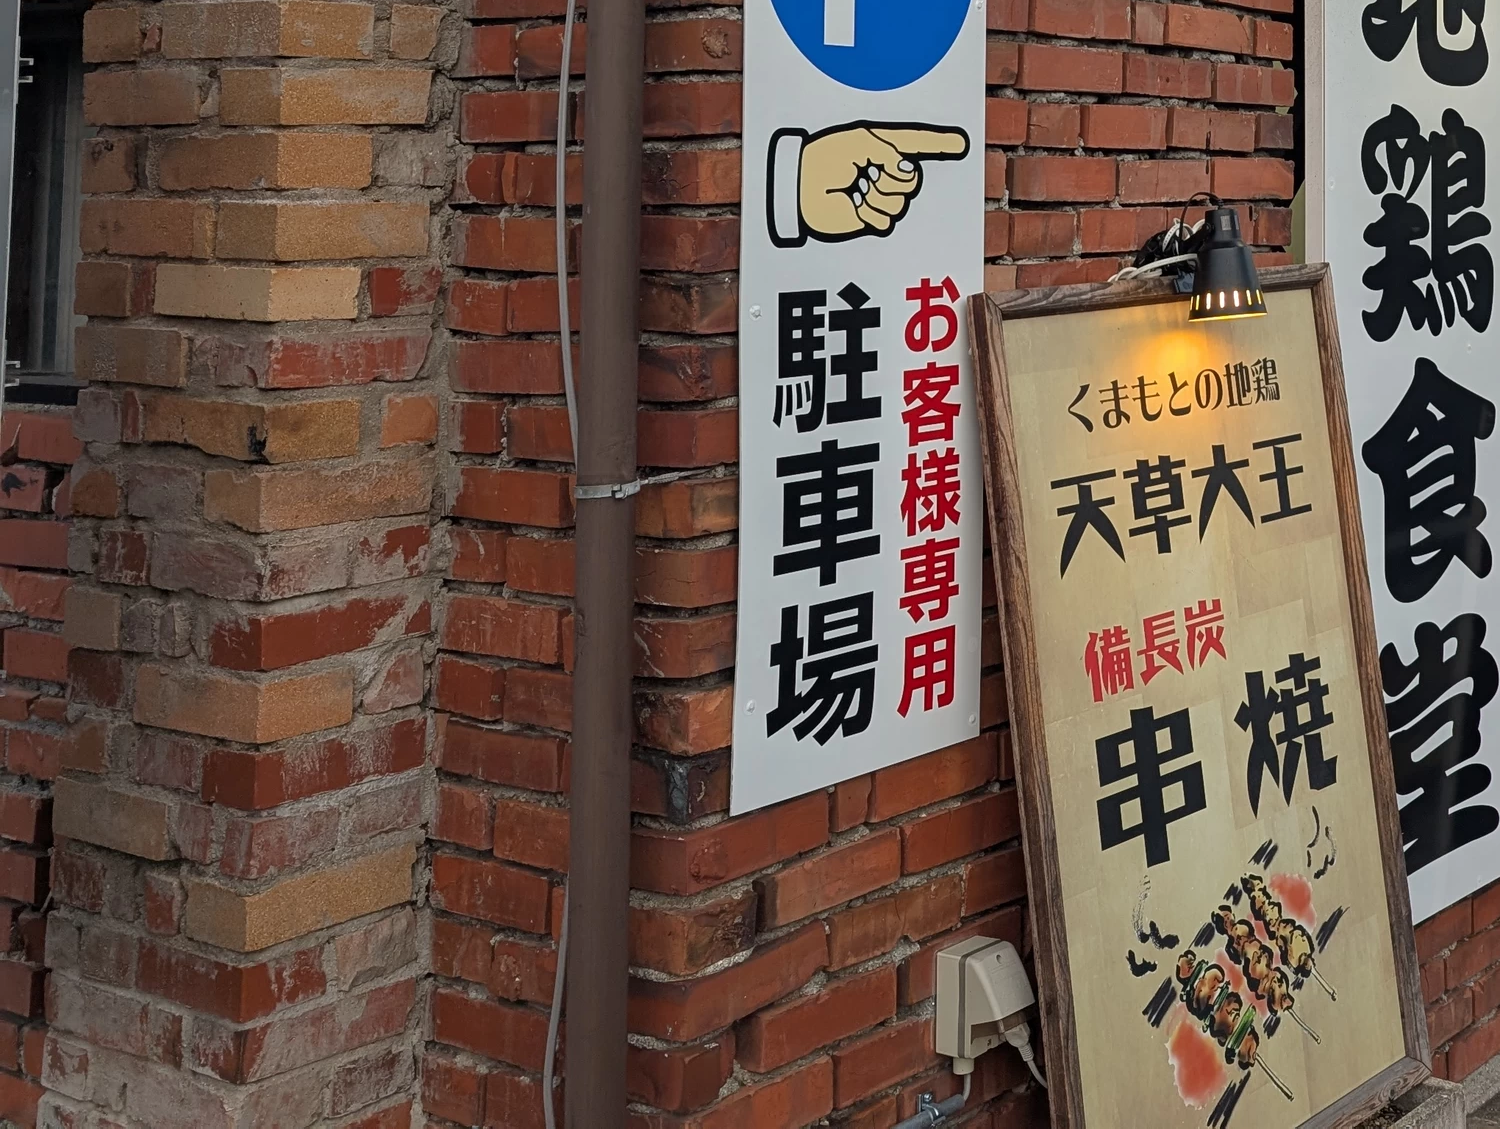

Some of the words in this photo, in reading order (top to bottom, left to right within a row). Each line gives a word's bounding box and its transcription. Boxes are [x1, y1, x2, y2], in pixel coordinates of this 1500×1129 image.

[1067, 356, 1281, 433] くまもとの地鶏
[766, 282, 883, 747] 駐車場
[897, 276, 962, 719] お客様専用
[1050, 433, 1313, 580] 天草大王
[1084, 597, 1228, 703] 備長炭
[1096, 652, 1339, 867] 串焼
